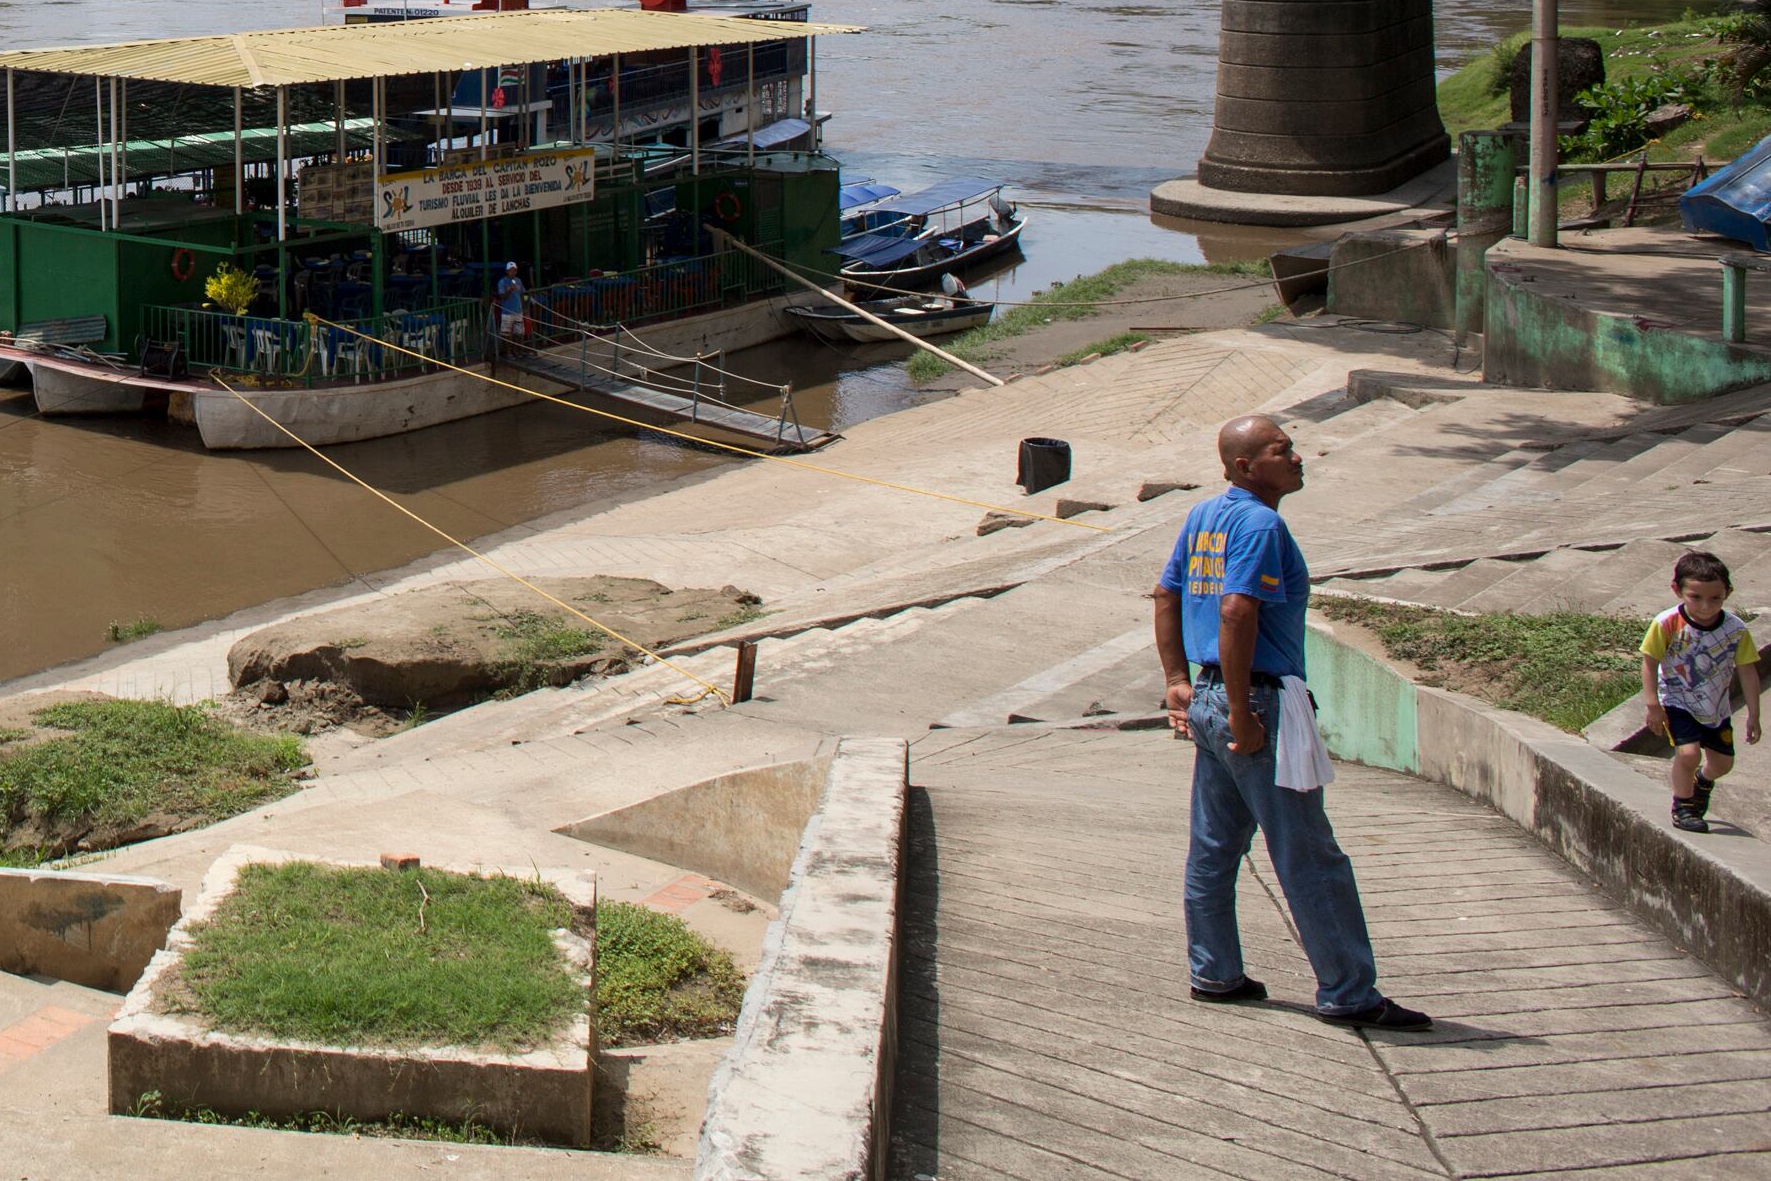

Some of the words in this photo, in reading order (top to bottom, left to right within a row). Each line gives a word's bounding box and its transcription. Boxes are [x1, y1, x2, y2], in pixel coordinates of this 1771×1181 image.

[423, 172, 434, 184] LA
[439, 168, 467, 181] BARCA
[472, 165, 487, 176] DEL
[493, 161, 528, 173] CAPITAN
[533, 156, 557, 168] ROZO
[442, 181, 463, 194] DESDE
[465, 179, 482, 192] 1939
[485, 176, 493, 188] AL
[498, 172, 526, 186] SERVICIO
[529, 169, 542, 181] DEL
[419, 197, 448, 211] TURISMO
[452, 193, 480, 207] FLUVIAL
[485, 190, 496, 201] LES
[500, 188, 508, 199] DA
[512, 186, 520, 197] LA
[525, 179, 562, 195] BIENVENIDA
[452, 205, 483, 219] ALQUILER
[488, 203, 497, 214] DE
[502, 197, 530, 212] LANCHAS
